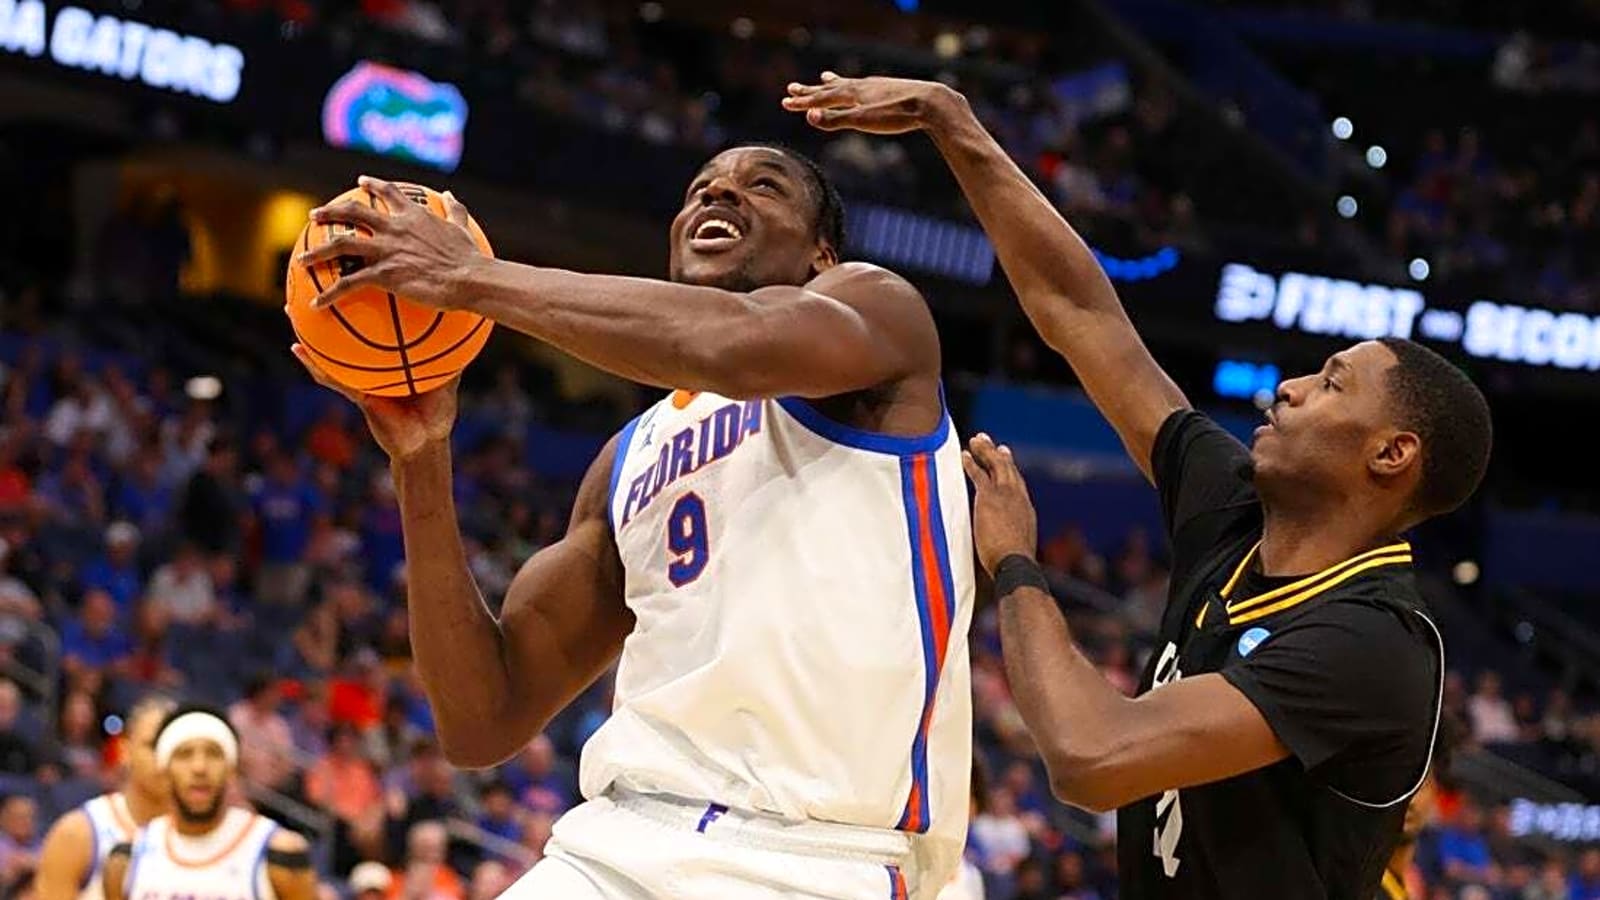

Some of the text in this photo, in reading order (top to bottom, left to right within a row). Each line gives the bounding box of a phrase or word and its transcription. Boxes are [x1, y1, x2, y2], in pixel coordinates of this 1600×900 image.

[51, 6, 244, 102] GATORS
[1273, 272, 1425, 341] FIRST
[1463, 300, 1600, 371] SECO
[621, 396, 764, 530] FLORIDA
[667, 490, 710, 589] 9
[696, 802, 729, 834] F
